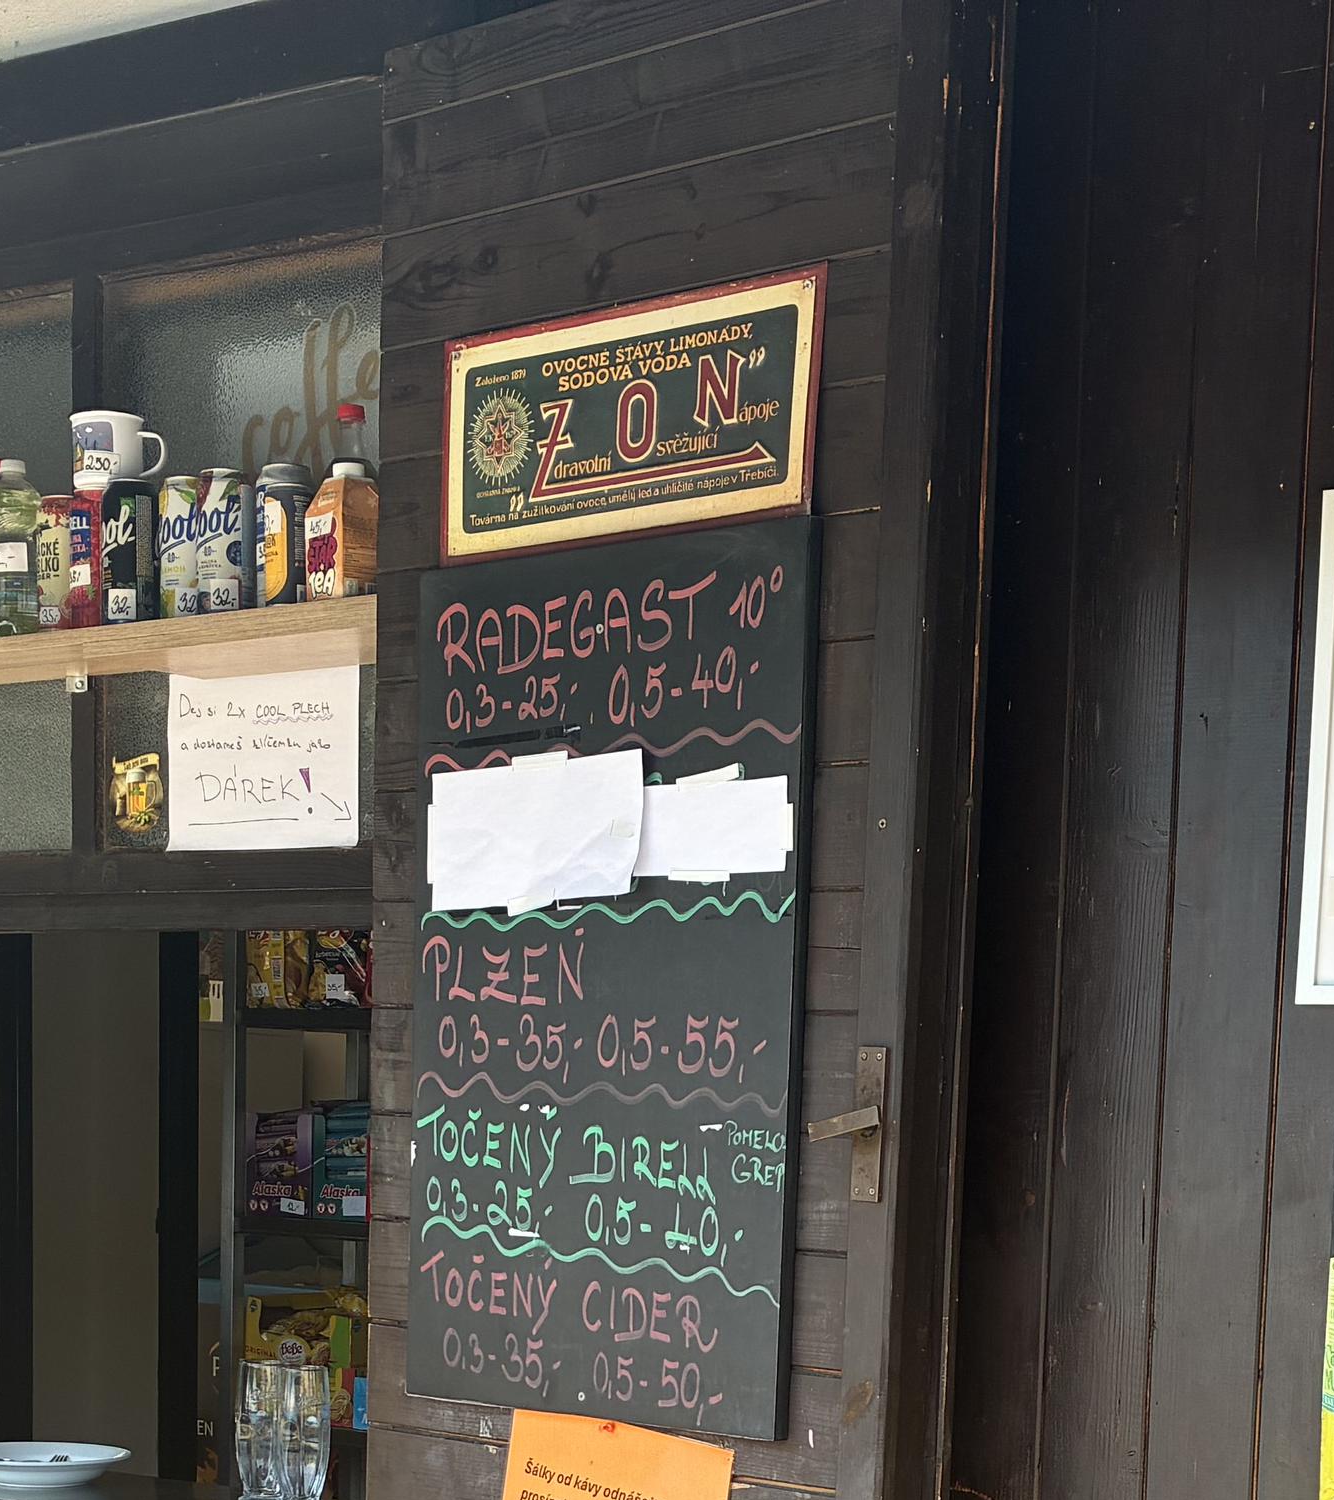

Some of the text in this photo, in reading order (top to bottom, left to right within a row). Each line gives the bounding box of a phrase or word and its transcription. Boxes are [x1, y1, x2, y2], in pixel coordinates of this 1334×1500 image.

[542, 348, 610, 377] OVOCNÉ
[558, 366, 633, 392] SODOVÁ
[470, 512, 506, 527] Továrna
[508, 512, 520, 523] na
[638, 486, 652, 499] led
[696, 475, 730, 492] nápoje
[437, 571, 717, 677] RADEGAST
[255, 703, 286, 719] COOL
[292, 702, 330, 716] PLECH
[180, 741, 189, 751] a
[422, 926, 586, 1006] PLZEŇ
[417, 1105, 563, 1188] TOČENÝ
[252, 1181, 292, 1198] Alaska
[420, 1249, 719, 1354] TOČENÝ CIDER
[524, 1457, 556, 1486] Šálky
[556, 1471, 572, 1487] od
[573, 1473, 602, 1498] kávy
